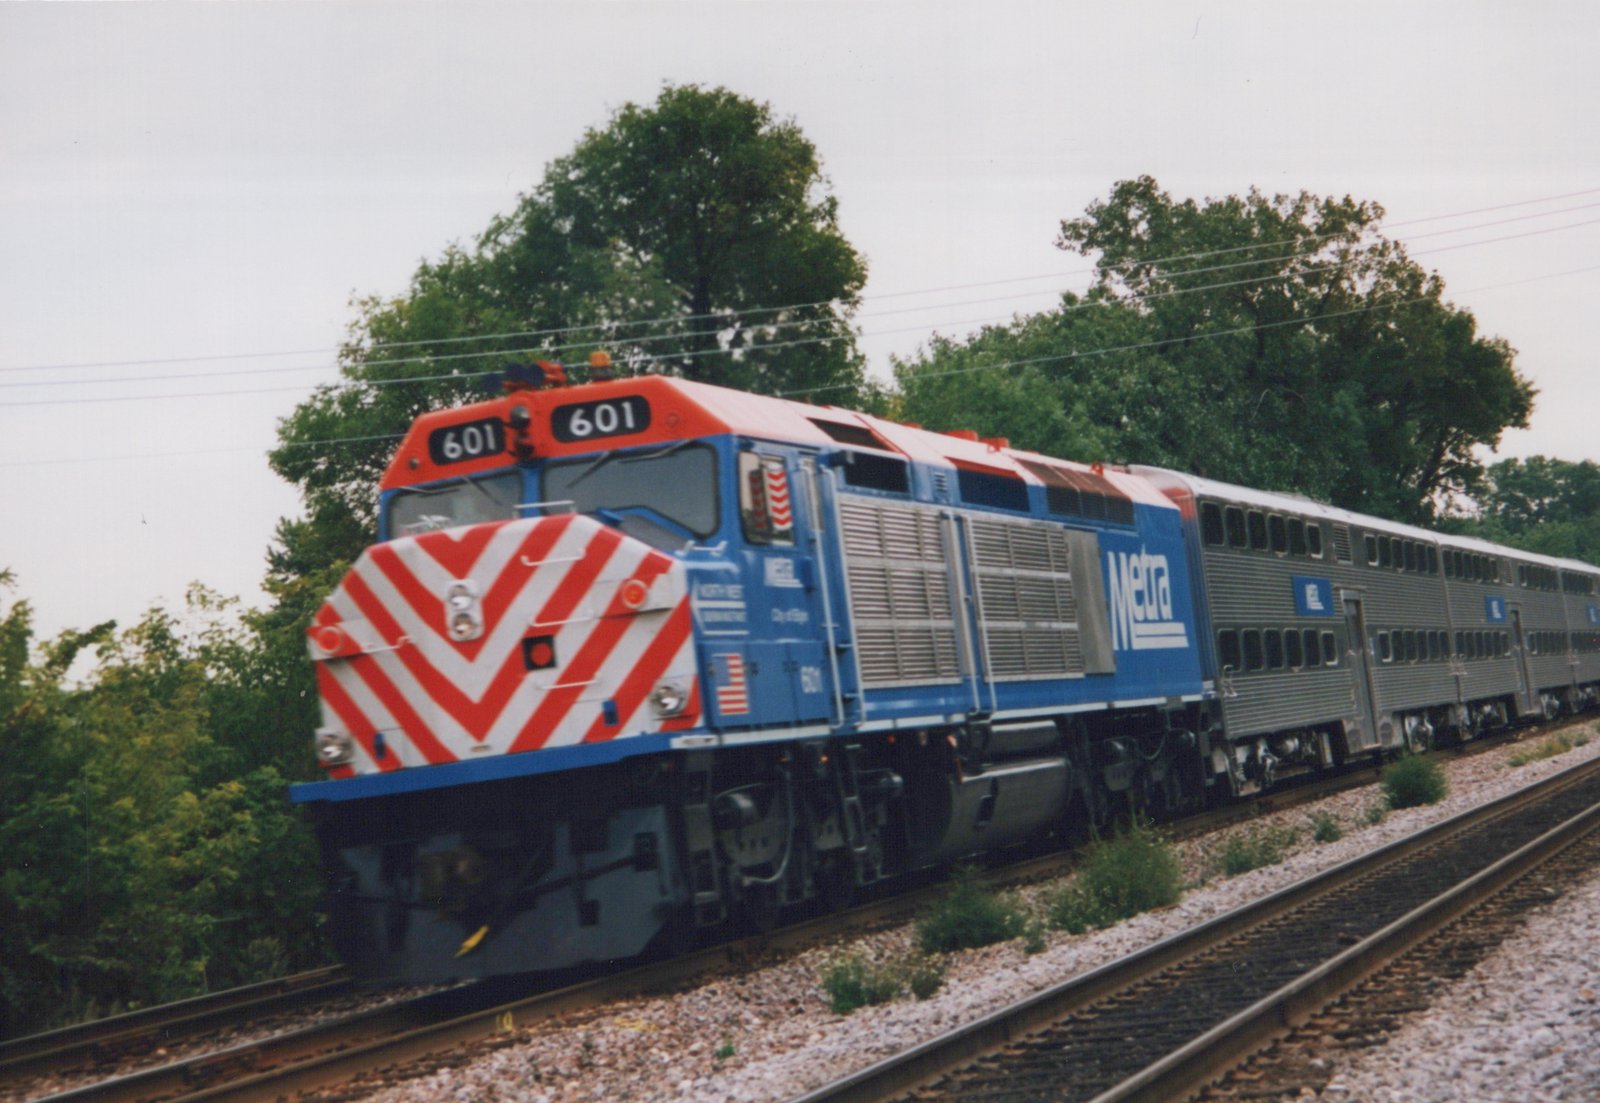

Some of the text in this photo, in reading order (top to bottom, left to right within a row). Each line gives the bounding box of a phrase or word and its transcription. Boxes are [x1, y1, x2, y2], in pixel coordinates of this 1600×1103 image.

[570, 402, 634, 436] 601
[443, 423, 495, 459] 601
[1107, 543, 1175, 651] Metra
